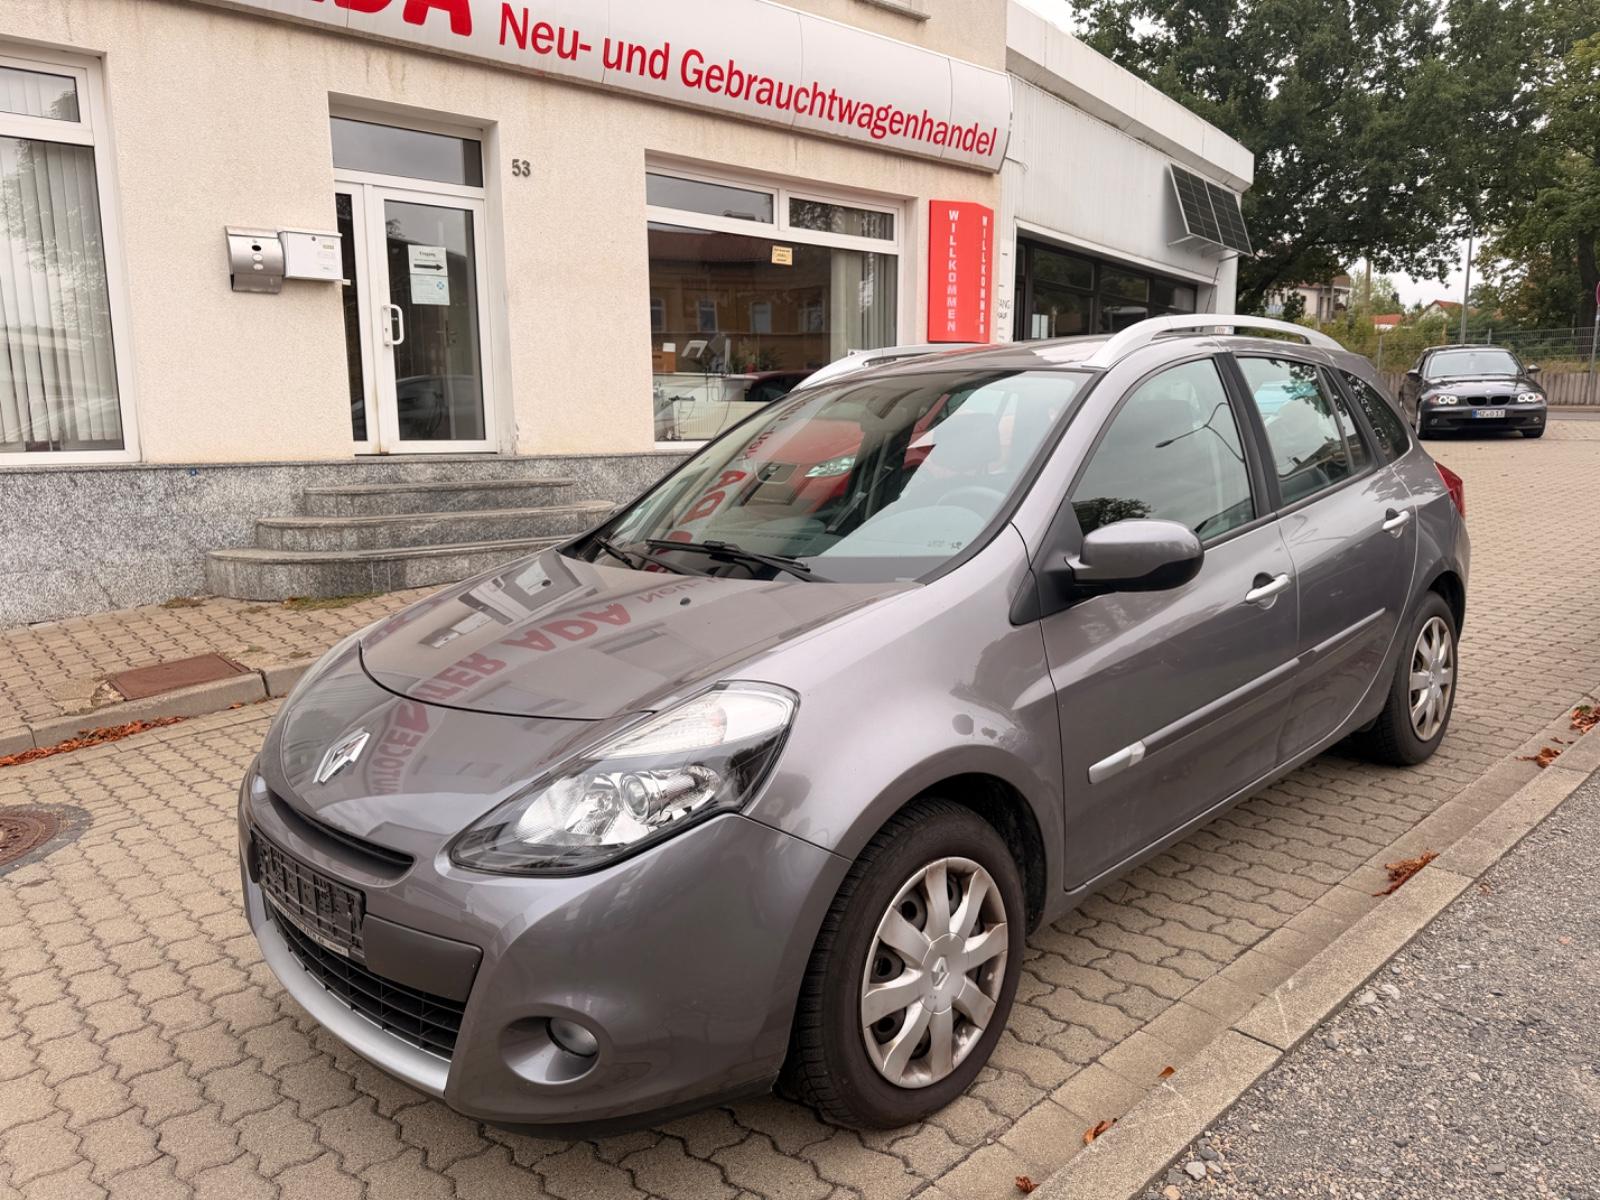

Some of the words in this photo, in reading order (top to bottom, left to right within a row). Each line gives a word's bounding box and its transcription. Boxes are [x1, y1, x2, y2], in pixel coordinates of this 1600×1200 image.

[499, 2, 592, 61] Neu-
[603, 37, 670, 81] und
[680, 48, 998, 157] Gebrauchtwagenhandel
[511, 158, 531, 178] 53
[946, 209, 959, 332] WILLKOMMEN
